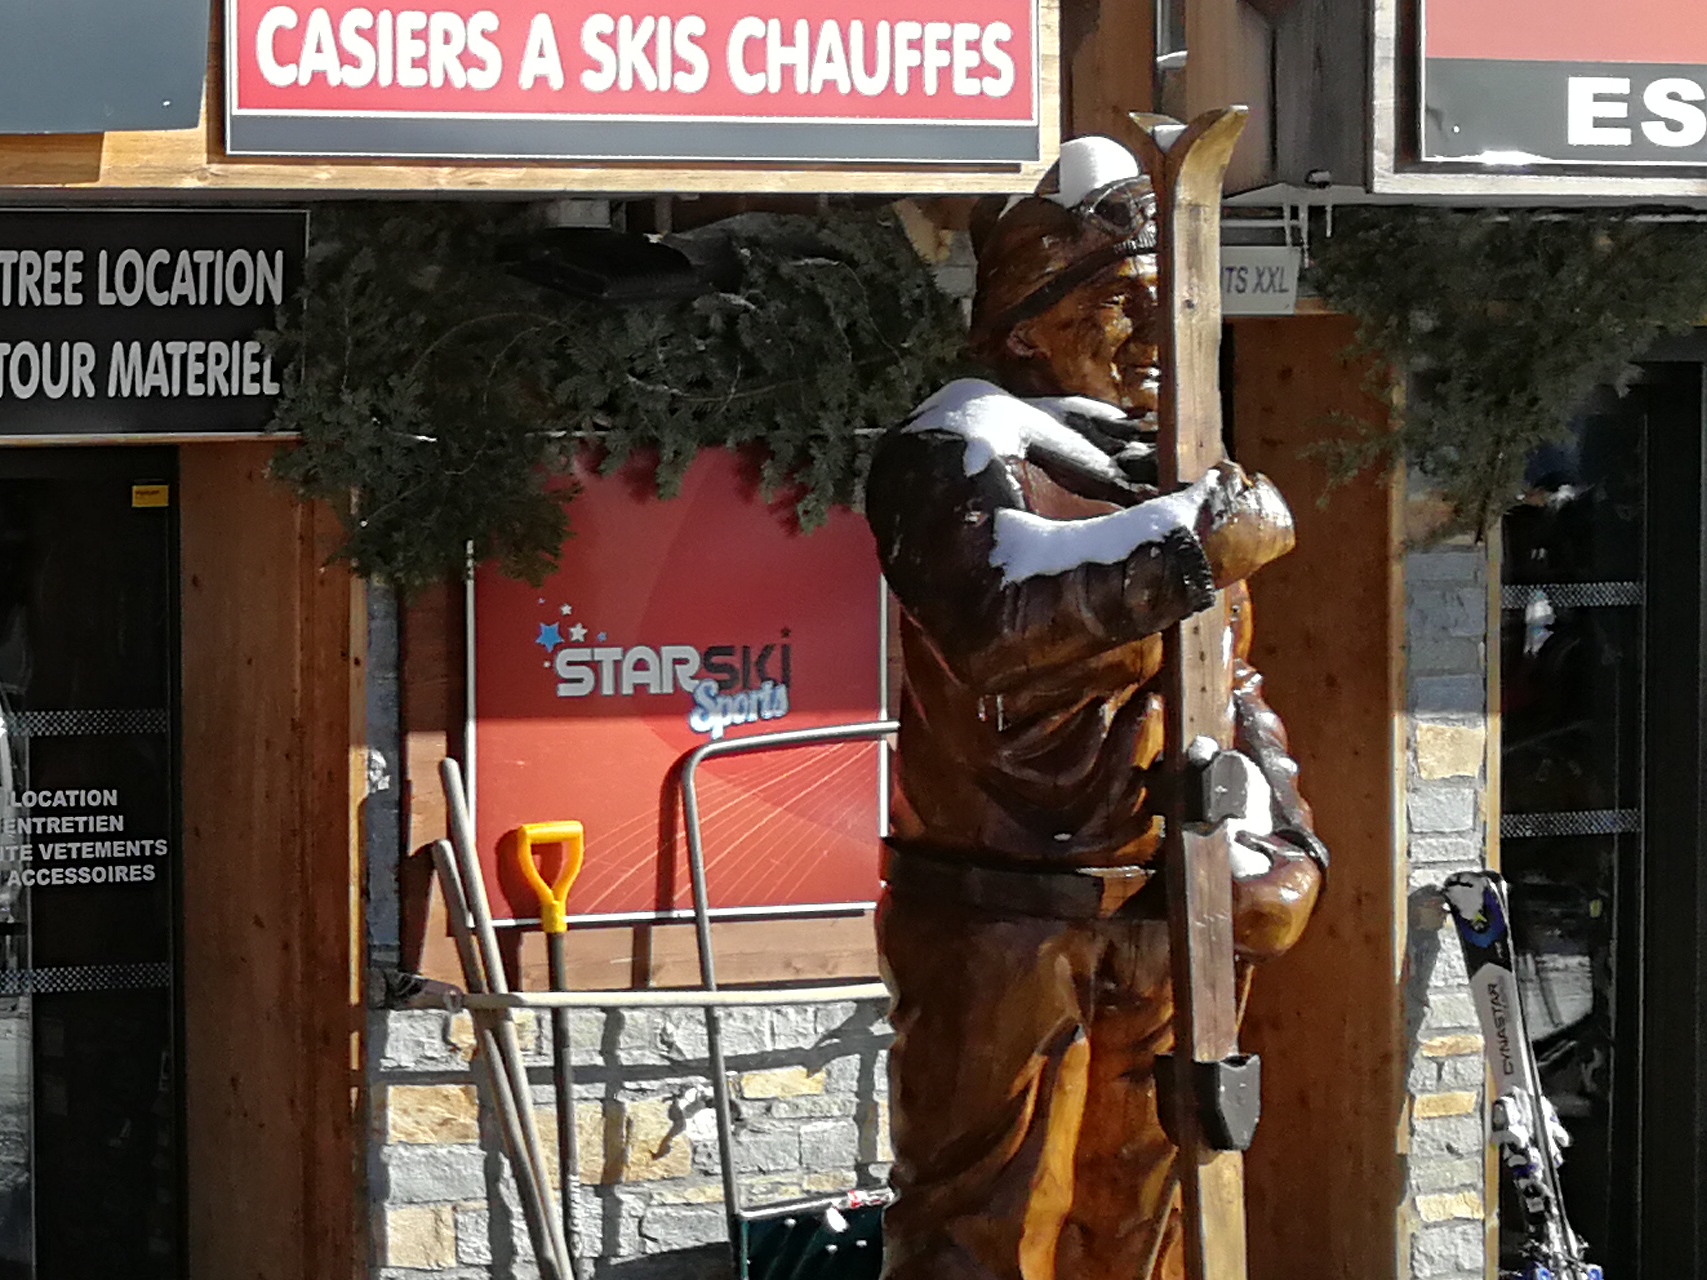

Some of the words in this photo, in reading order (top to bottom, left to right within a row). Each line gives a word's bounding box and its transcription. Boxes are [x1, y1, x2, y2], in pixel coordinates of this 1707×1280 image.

[255, 4, 503, 95] CASIERS
[520, 12, 565, 91] A
[580, 12, 710, 96] SKIS
[725, 16, 1016, 99] CHAUFFES
[1568, 76, 1707, 148] ES
[97, 247, 284, 307] LOCATION
[1221, 265, 1249, 295] TS
[1252, 265, 1290, 294] XXL
[107, 340, 281, 398] MATERIEL
[689, 678, 789, 740] Sports
[9, 788, 119, 809] LOCATION
[2, 814, 125, 835] ENTRETIEN
[38, 838, 169, 861] VETEMENTS
[6, 864, 157, 887] ACCESSOIRES
